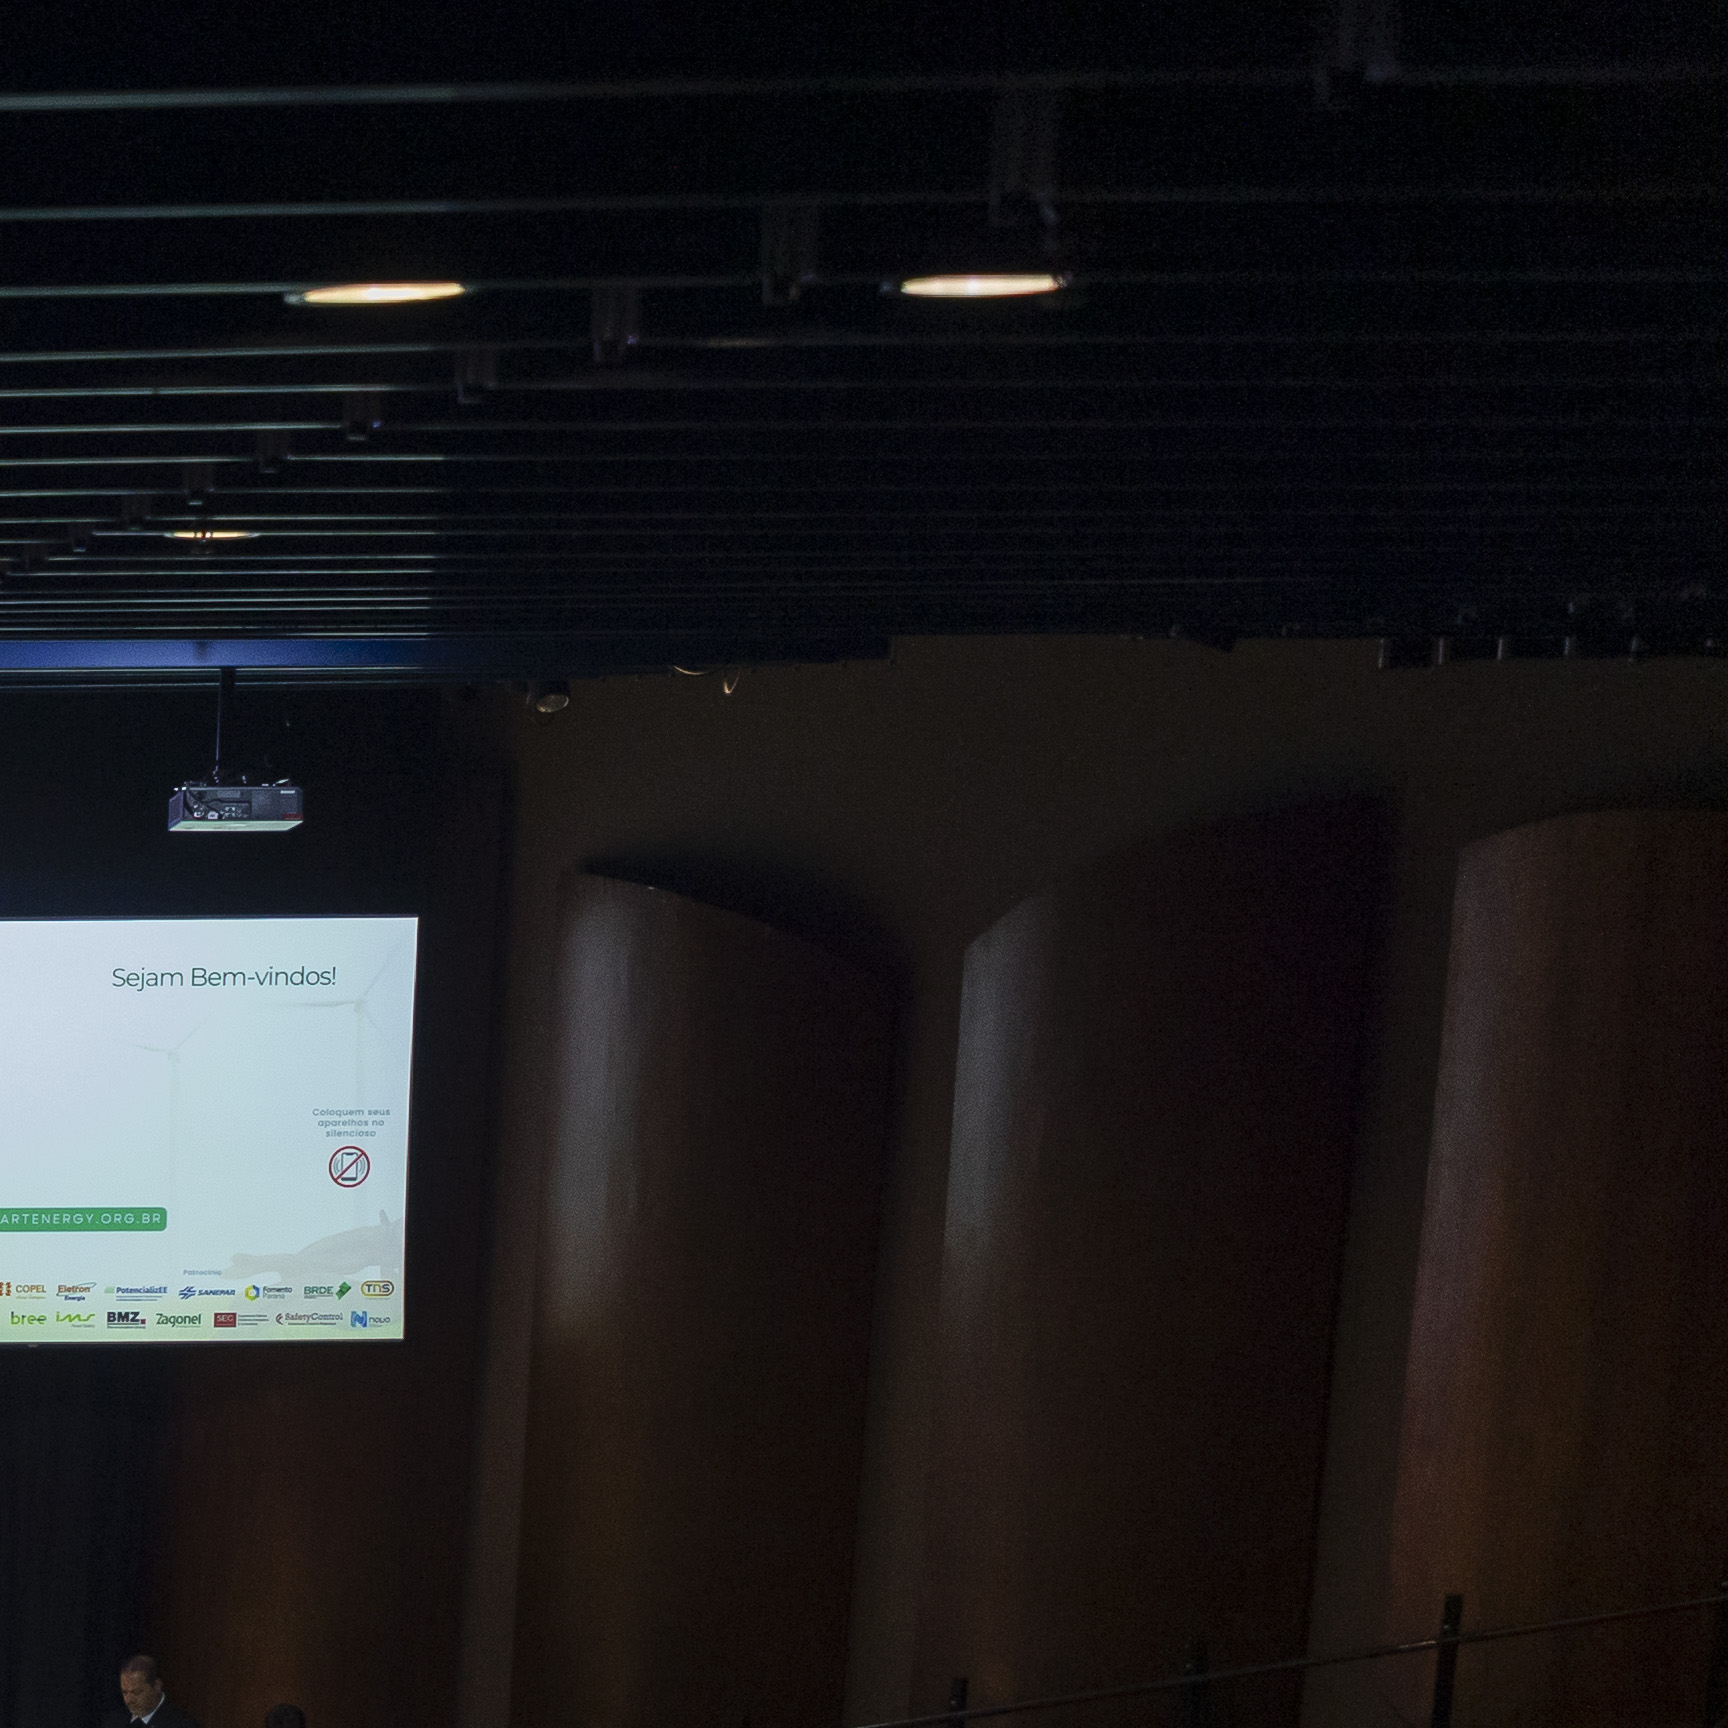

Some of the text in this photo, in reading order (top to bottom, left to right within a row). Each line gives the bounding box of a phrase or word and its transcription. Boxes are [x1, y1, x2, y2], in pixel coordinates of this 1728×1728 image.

[112, 965, 337, 992] Sejam Bem-vindos!
[312, 1108, 391, 1118] Coloquem seus
[317, 1118, 385, 1128] aparelhos no
[325, 1129, 377, 1138] silencioso
[15, 1284, 47, 1294] COPEL
[57, 1284, 91, 1294] Eletron
[197, 1289, 236, 1297] SANEPAR
[262, 1285, 293, 1295] Fomento
[303, 1285, 334, 1295] BRDE
[10, 1311, 47, 1325] bree
[155, 1313, 202, 1328] Zagonel
[284, 1312, 344, 1324] SafetyControl
